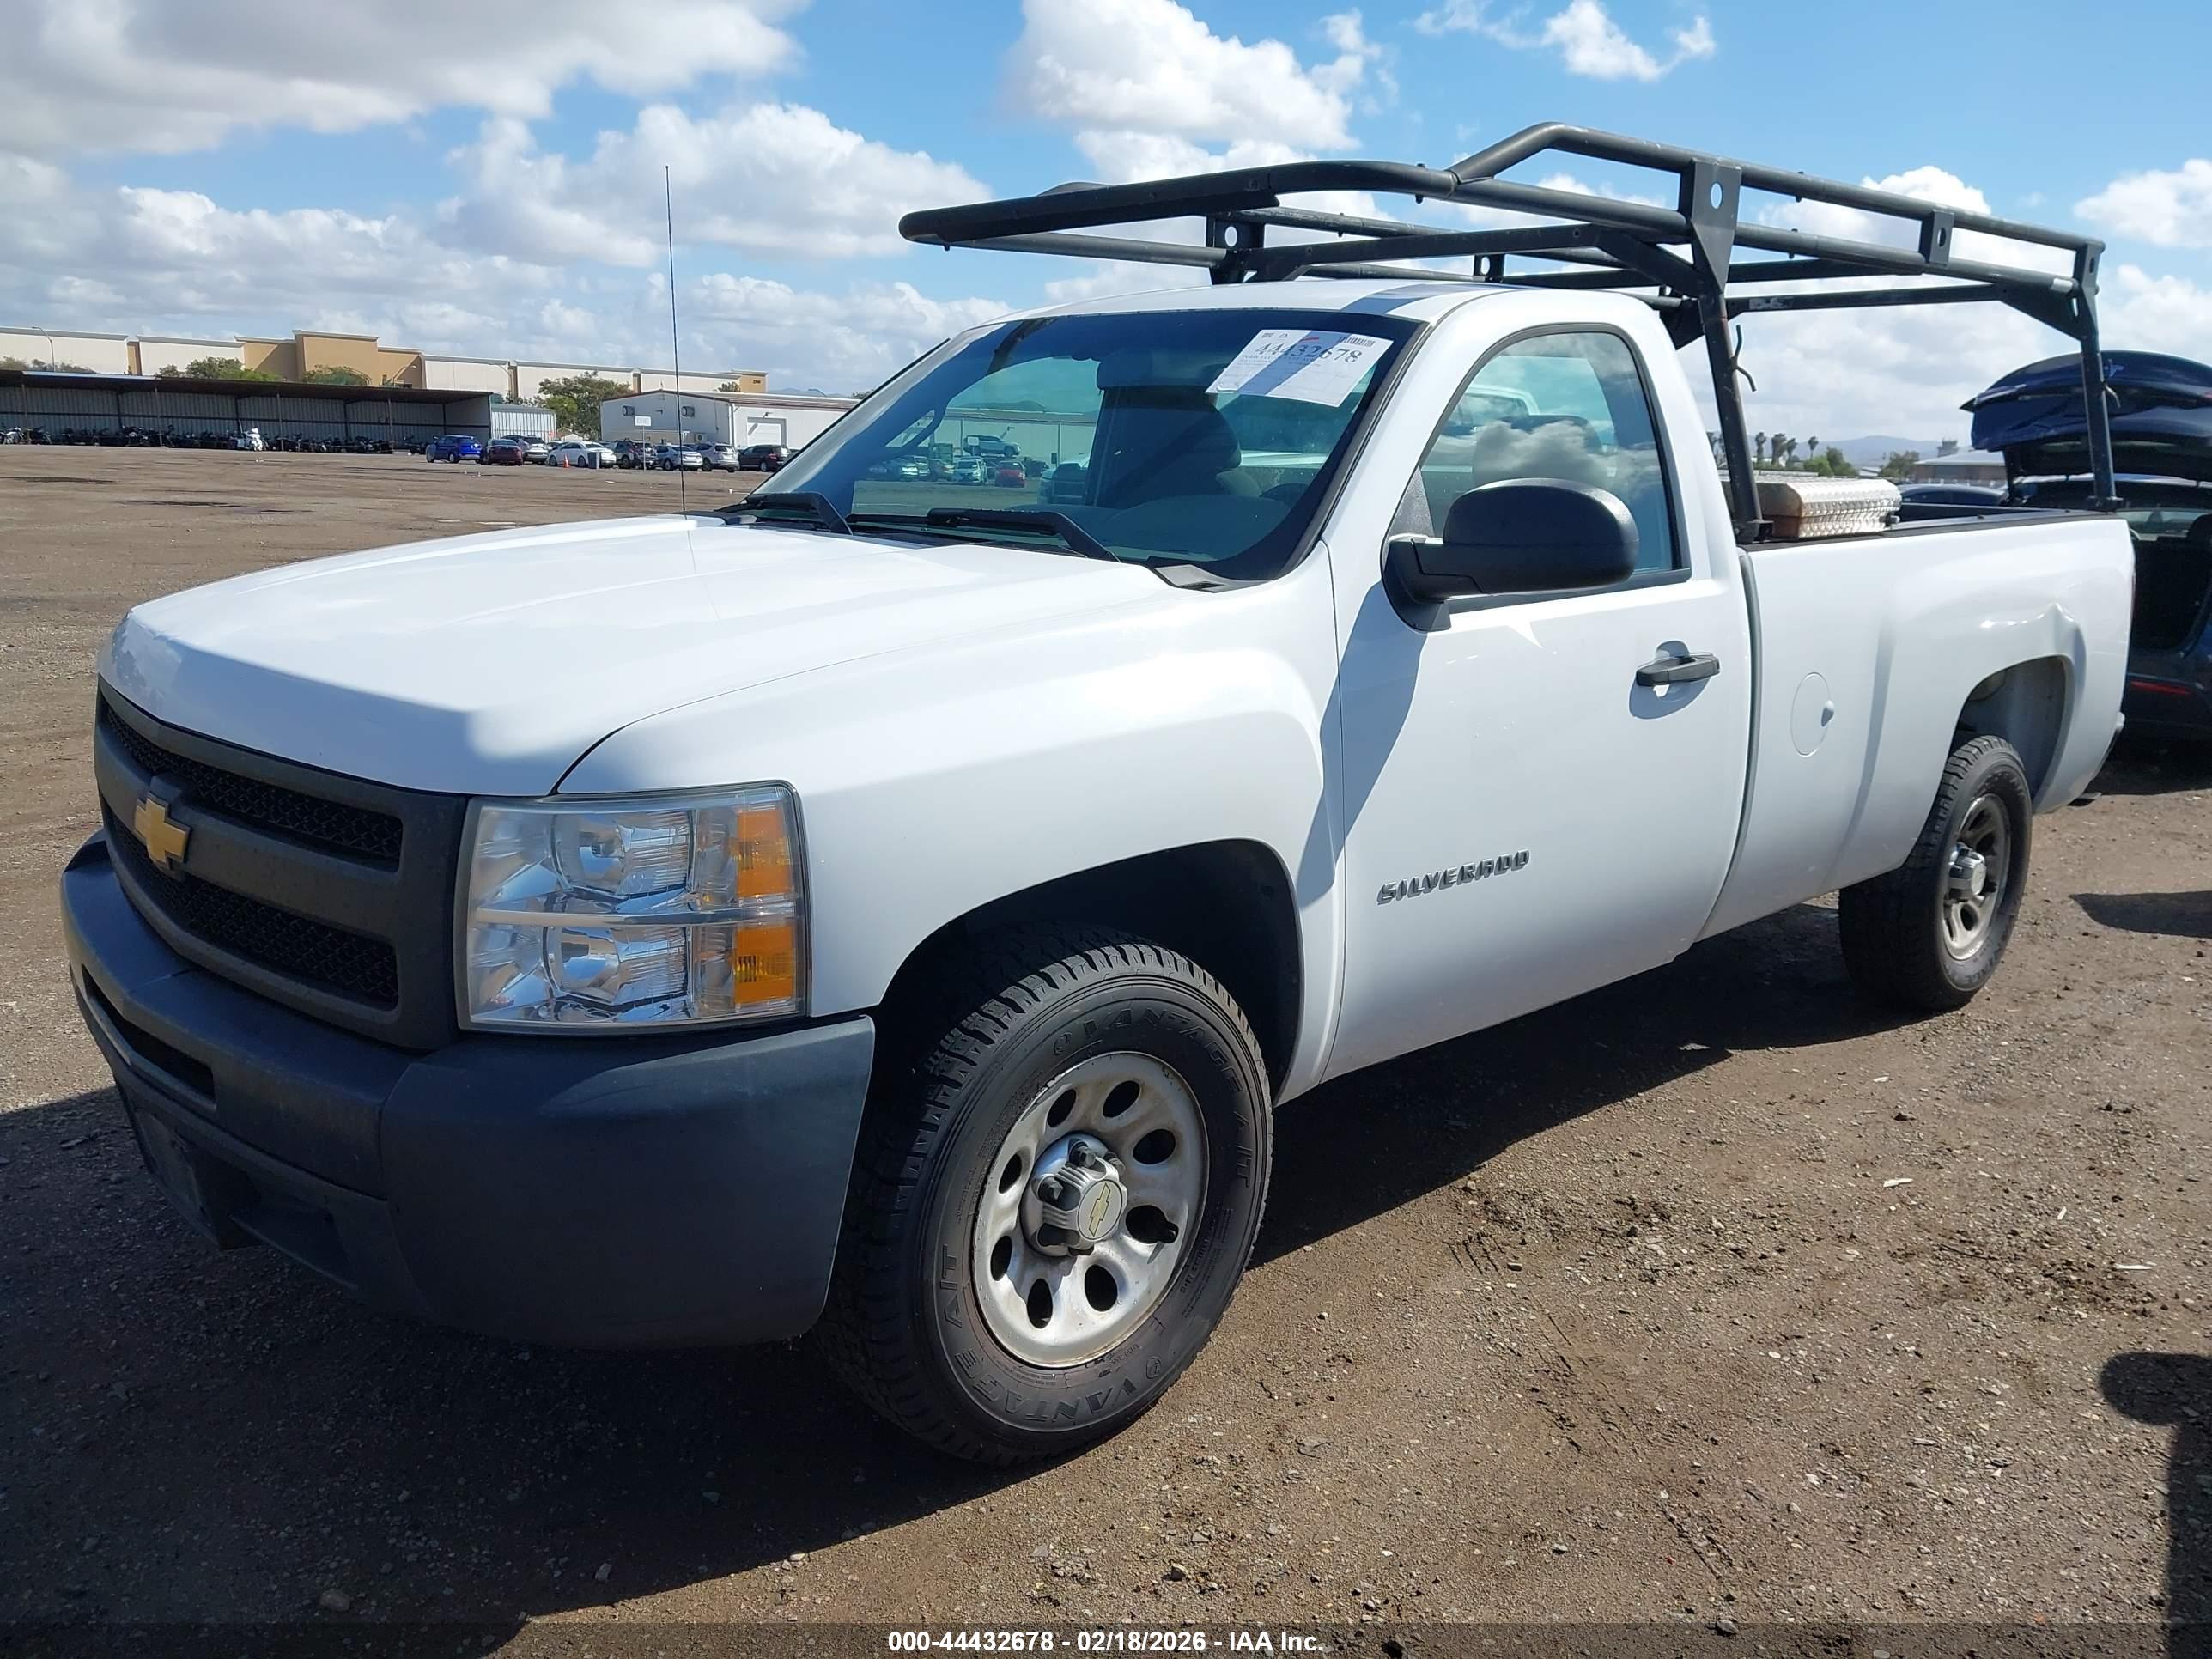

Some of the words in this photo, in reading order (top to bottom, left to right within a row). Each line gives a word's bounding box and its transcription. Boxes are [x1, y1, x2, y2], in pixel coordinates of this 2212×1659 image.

[1255, 343, 1363, 364] 44432678
[1376, 849, 1530, 906] SILVERADO
[954, 1348, 1138, 1424] VANTAGE
